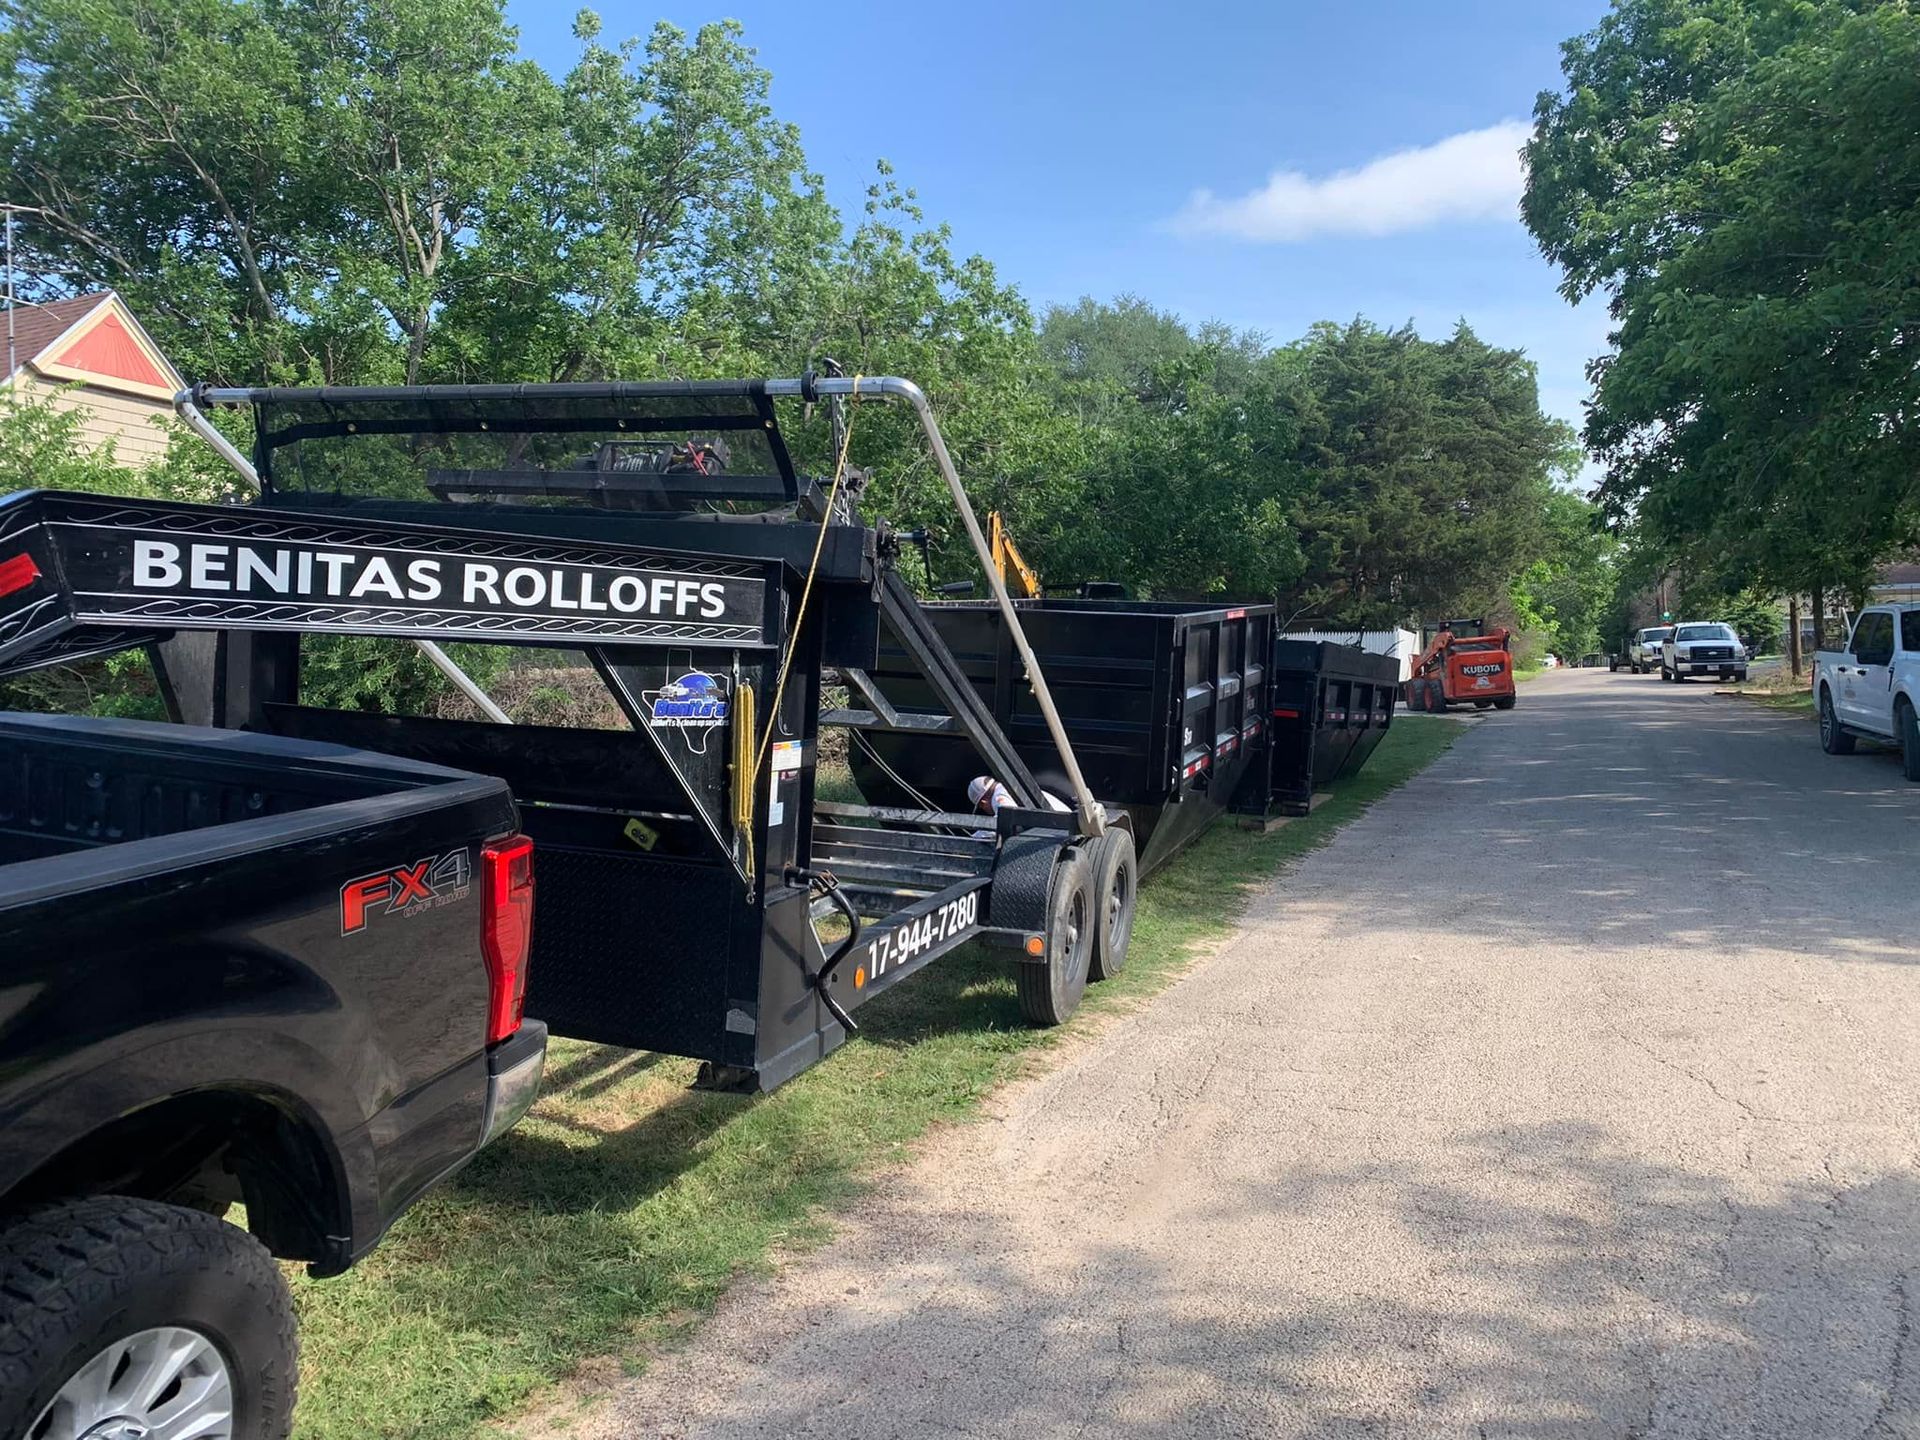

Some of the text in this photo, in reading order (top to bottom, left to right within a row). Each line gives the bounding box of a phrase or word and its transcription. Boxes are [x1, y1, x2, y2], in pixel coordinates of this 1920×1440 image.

[133, 539, 725, 618] BENITAS ROLLOFFS
[653, 699, 727, 718] Benita's
[1463, 664, 1501, 674] KUBOTA
[340, 847, 471, 937] FX4
[868, 891, 976, 979] 17-944-7280
